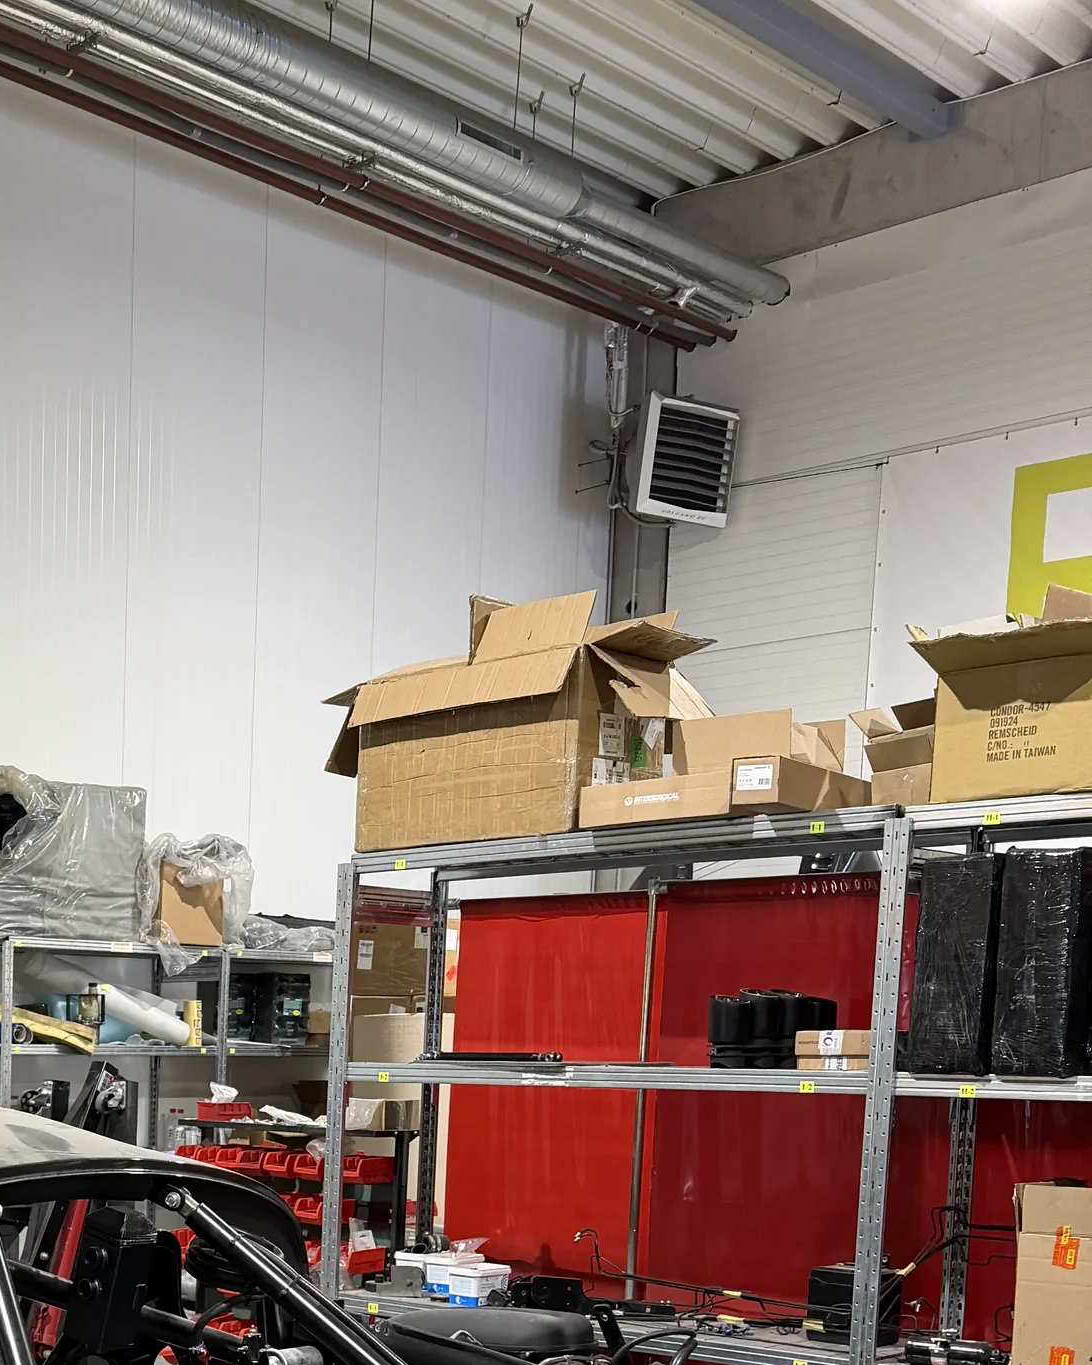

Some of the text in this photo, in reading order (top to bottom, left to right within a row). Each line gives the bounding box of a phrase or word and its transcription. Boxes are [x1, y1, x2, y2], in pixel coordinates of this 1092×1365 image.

[990, 701, 1051, 716] CONDOR-4547
[990, 716, 1018, 728] 091924
[989, 726, 1037, 740] REMSCHEID
[987, 740, 1013, 751] C/NO.:
[987, 746, 1057, 762] MADE IN TAIWAN
